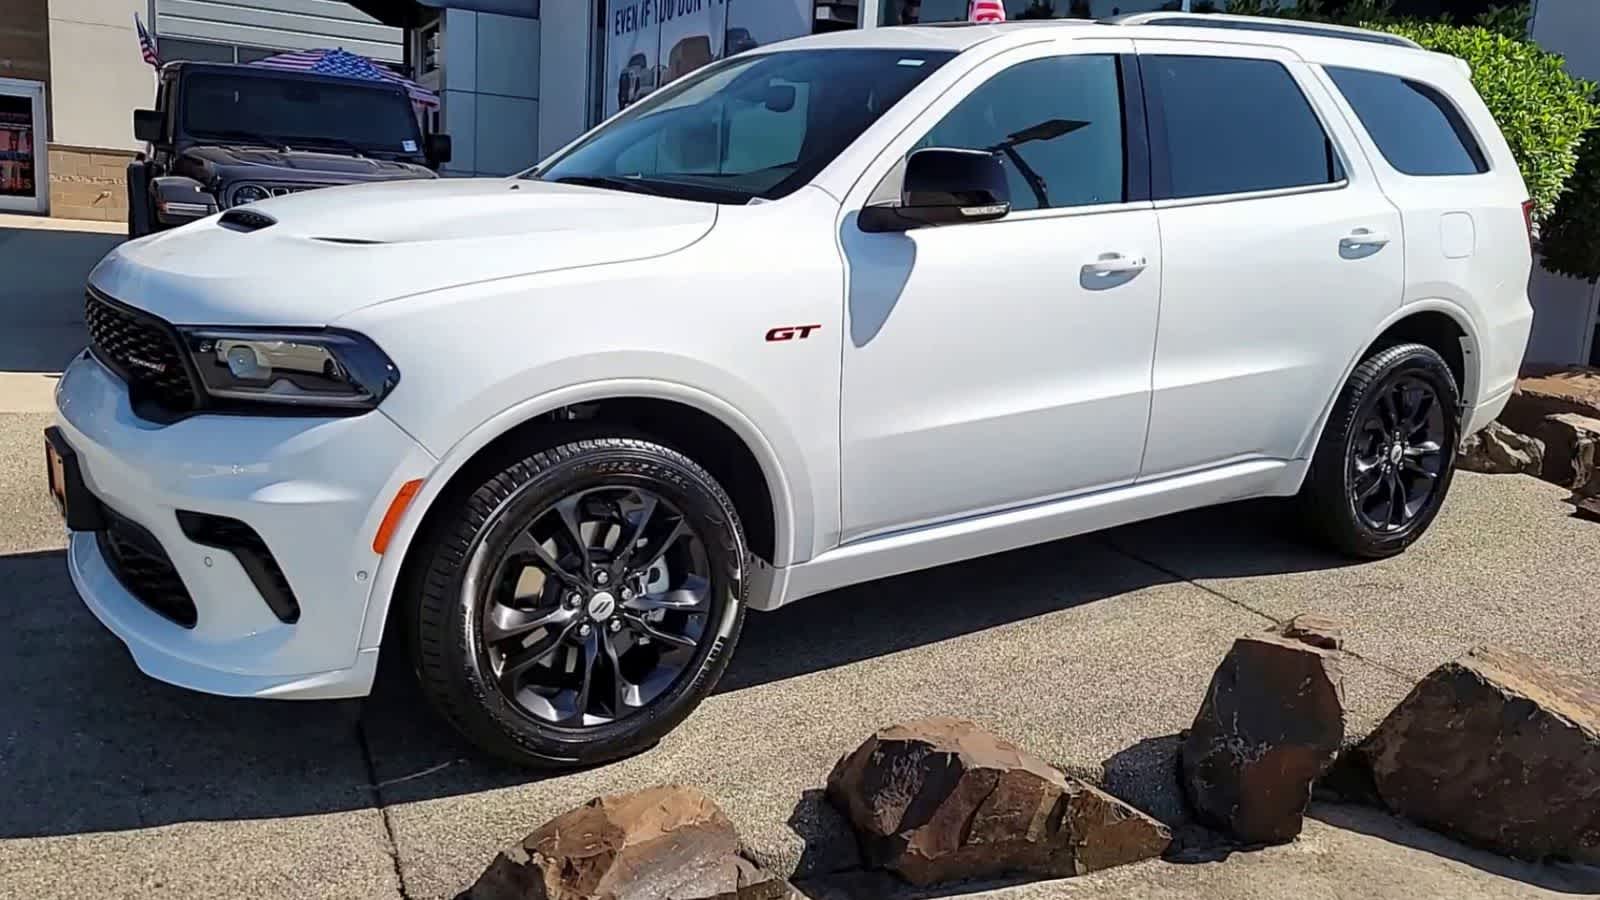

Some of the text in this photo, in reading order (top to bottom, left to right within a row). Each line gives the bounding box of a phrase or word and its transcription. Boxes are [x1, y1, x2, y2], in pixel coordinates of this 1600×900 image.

[615, 4, 639, 36] EVEN
[641, 0, 651, 28] IF
[765, 324, 822, 342] GT
